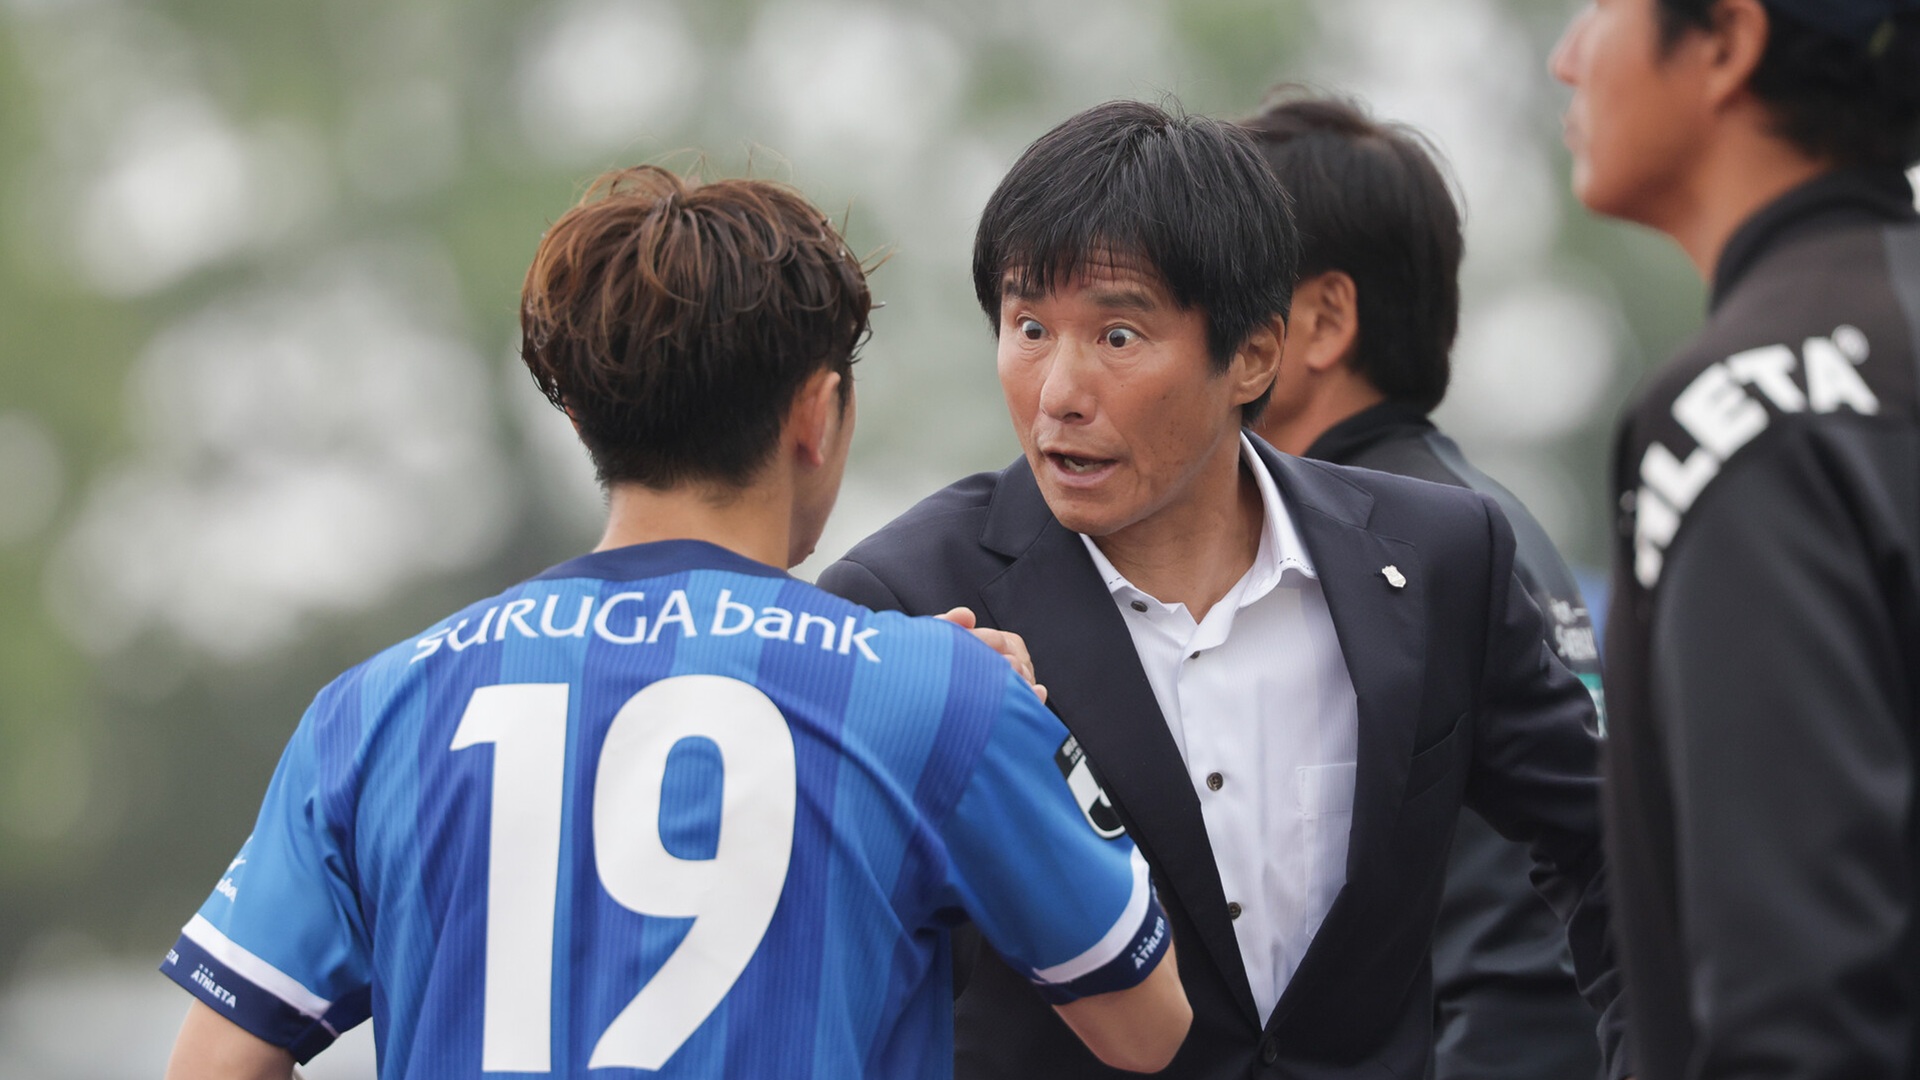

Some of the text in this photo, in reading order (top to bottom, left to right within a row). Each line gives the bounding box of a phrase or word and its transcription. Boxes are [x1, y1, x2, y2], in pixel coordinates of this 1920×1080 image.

[409, 589, 881, 664] SURUGA bank
[449, 674, 797, 1073] 19
[1135, 916, 1165, 969] ATHLETA
[190, 969, 236, 1008] ATHLETA
